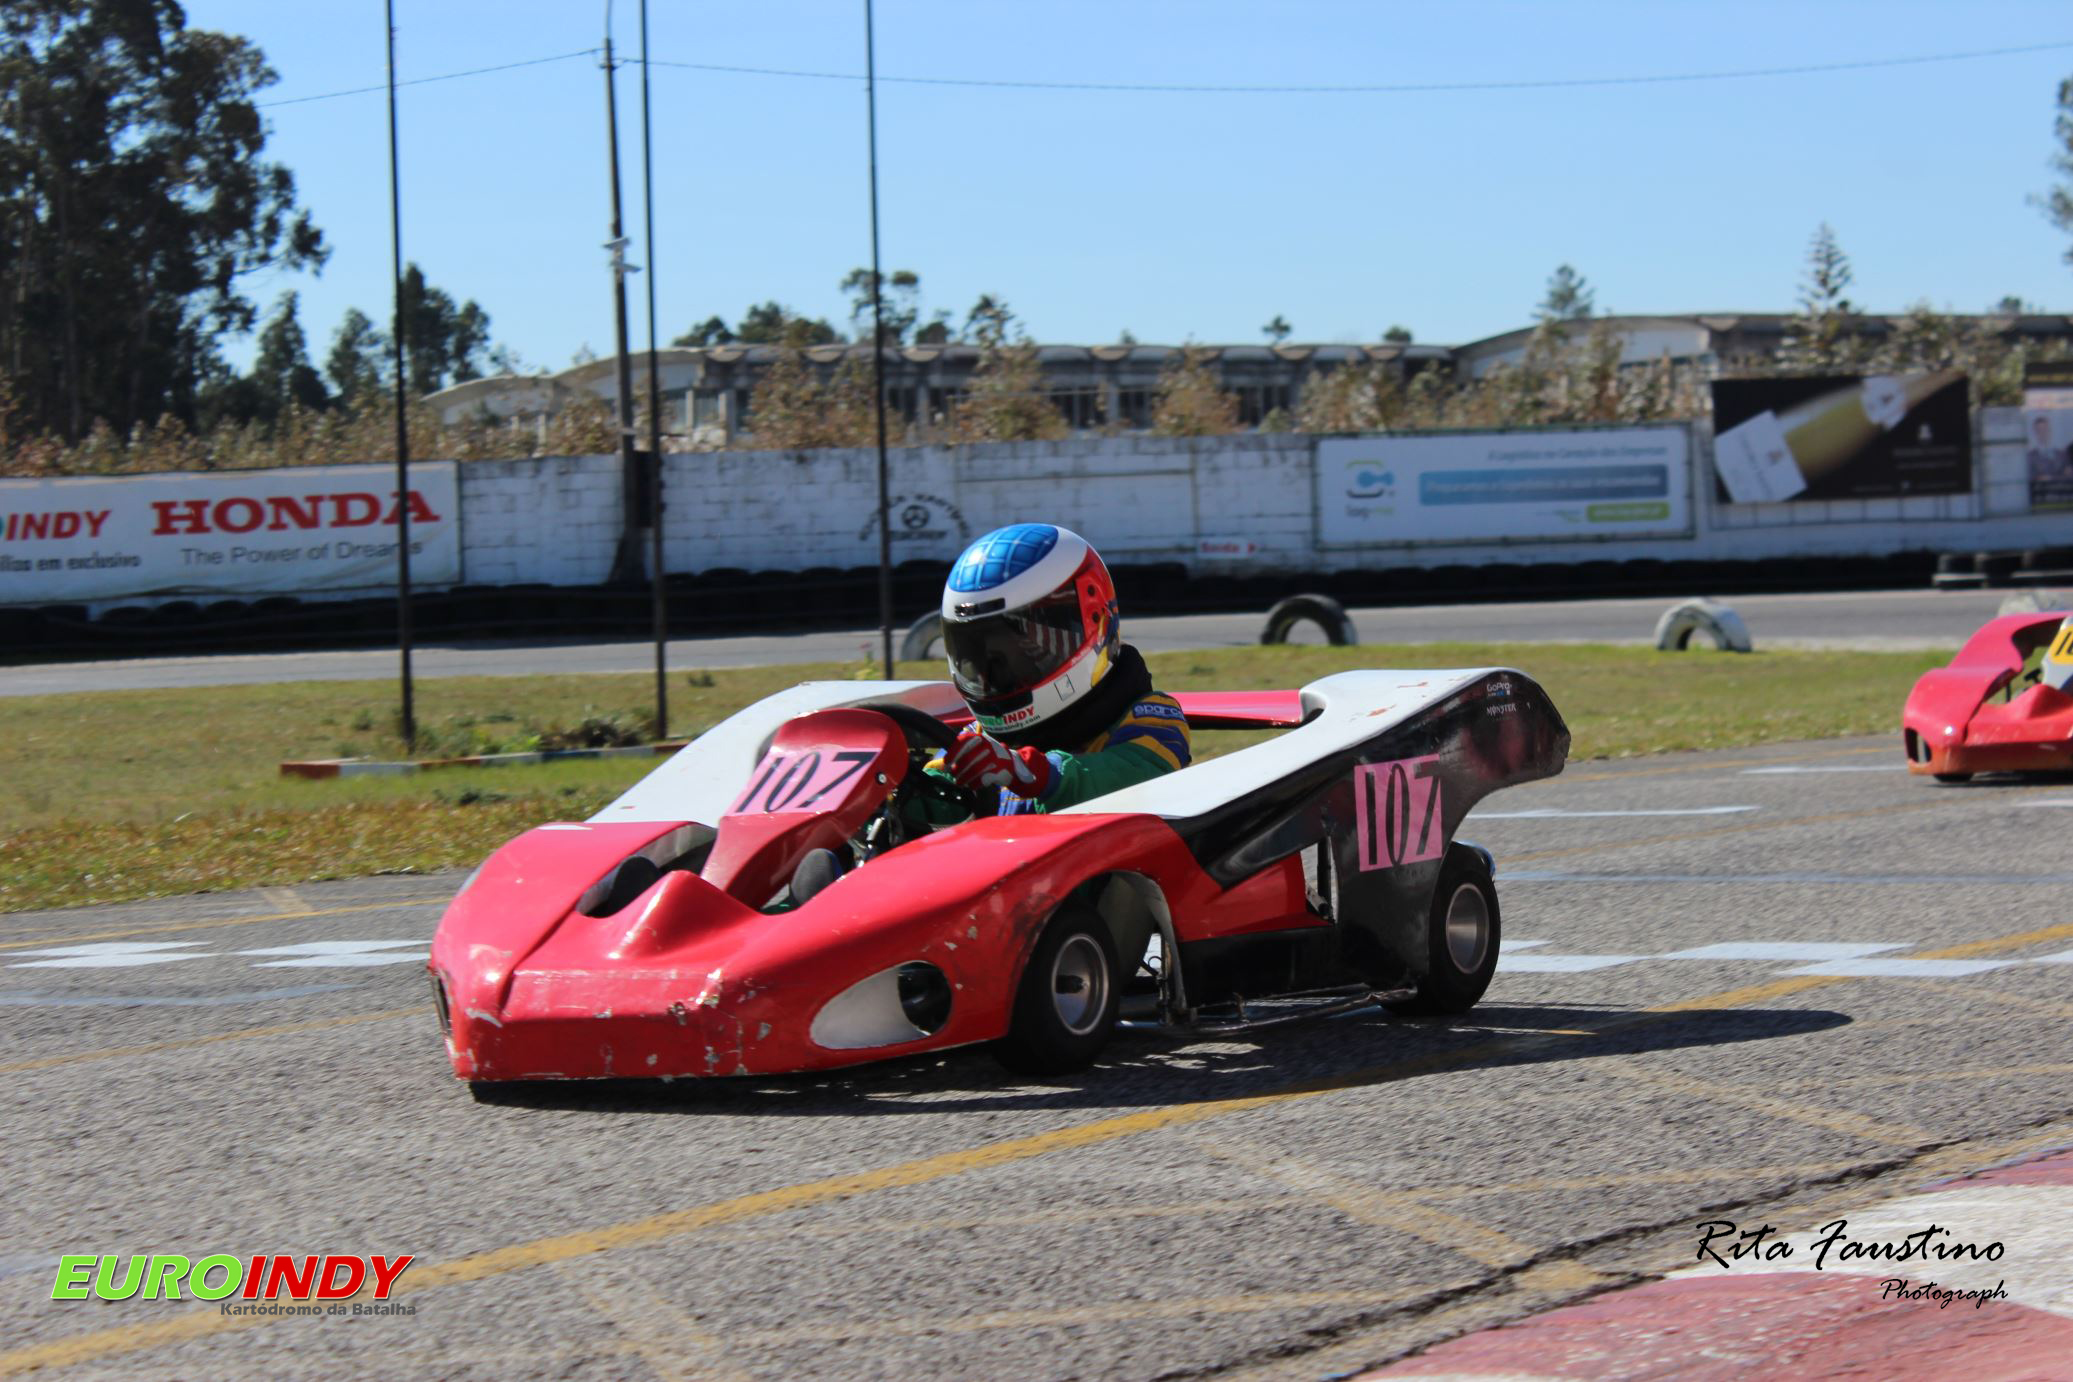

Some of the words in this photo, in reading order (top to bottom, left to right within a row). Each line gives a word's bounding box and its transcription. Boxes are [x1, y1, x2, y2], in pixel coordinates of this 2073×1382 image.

[0, 510, 112, 541] INDY
[152, 490, 441, 536] HONDA
[181, 547, 224, 566] The
[230, 546, 299, 564] Power
[307, 542, 329, 560] of
[734, 751, 880, 813] 107
[1364, 759, 1441, 866] 107
